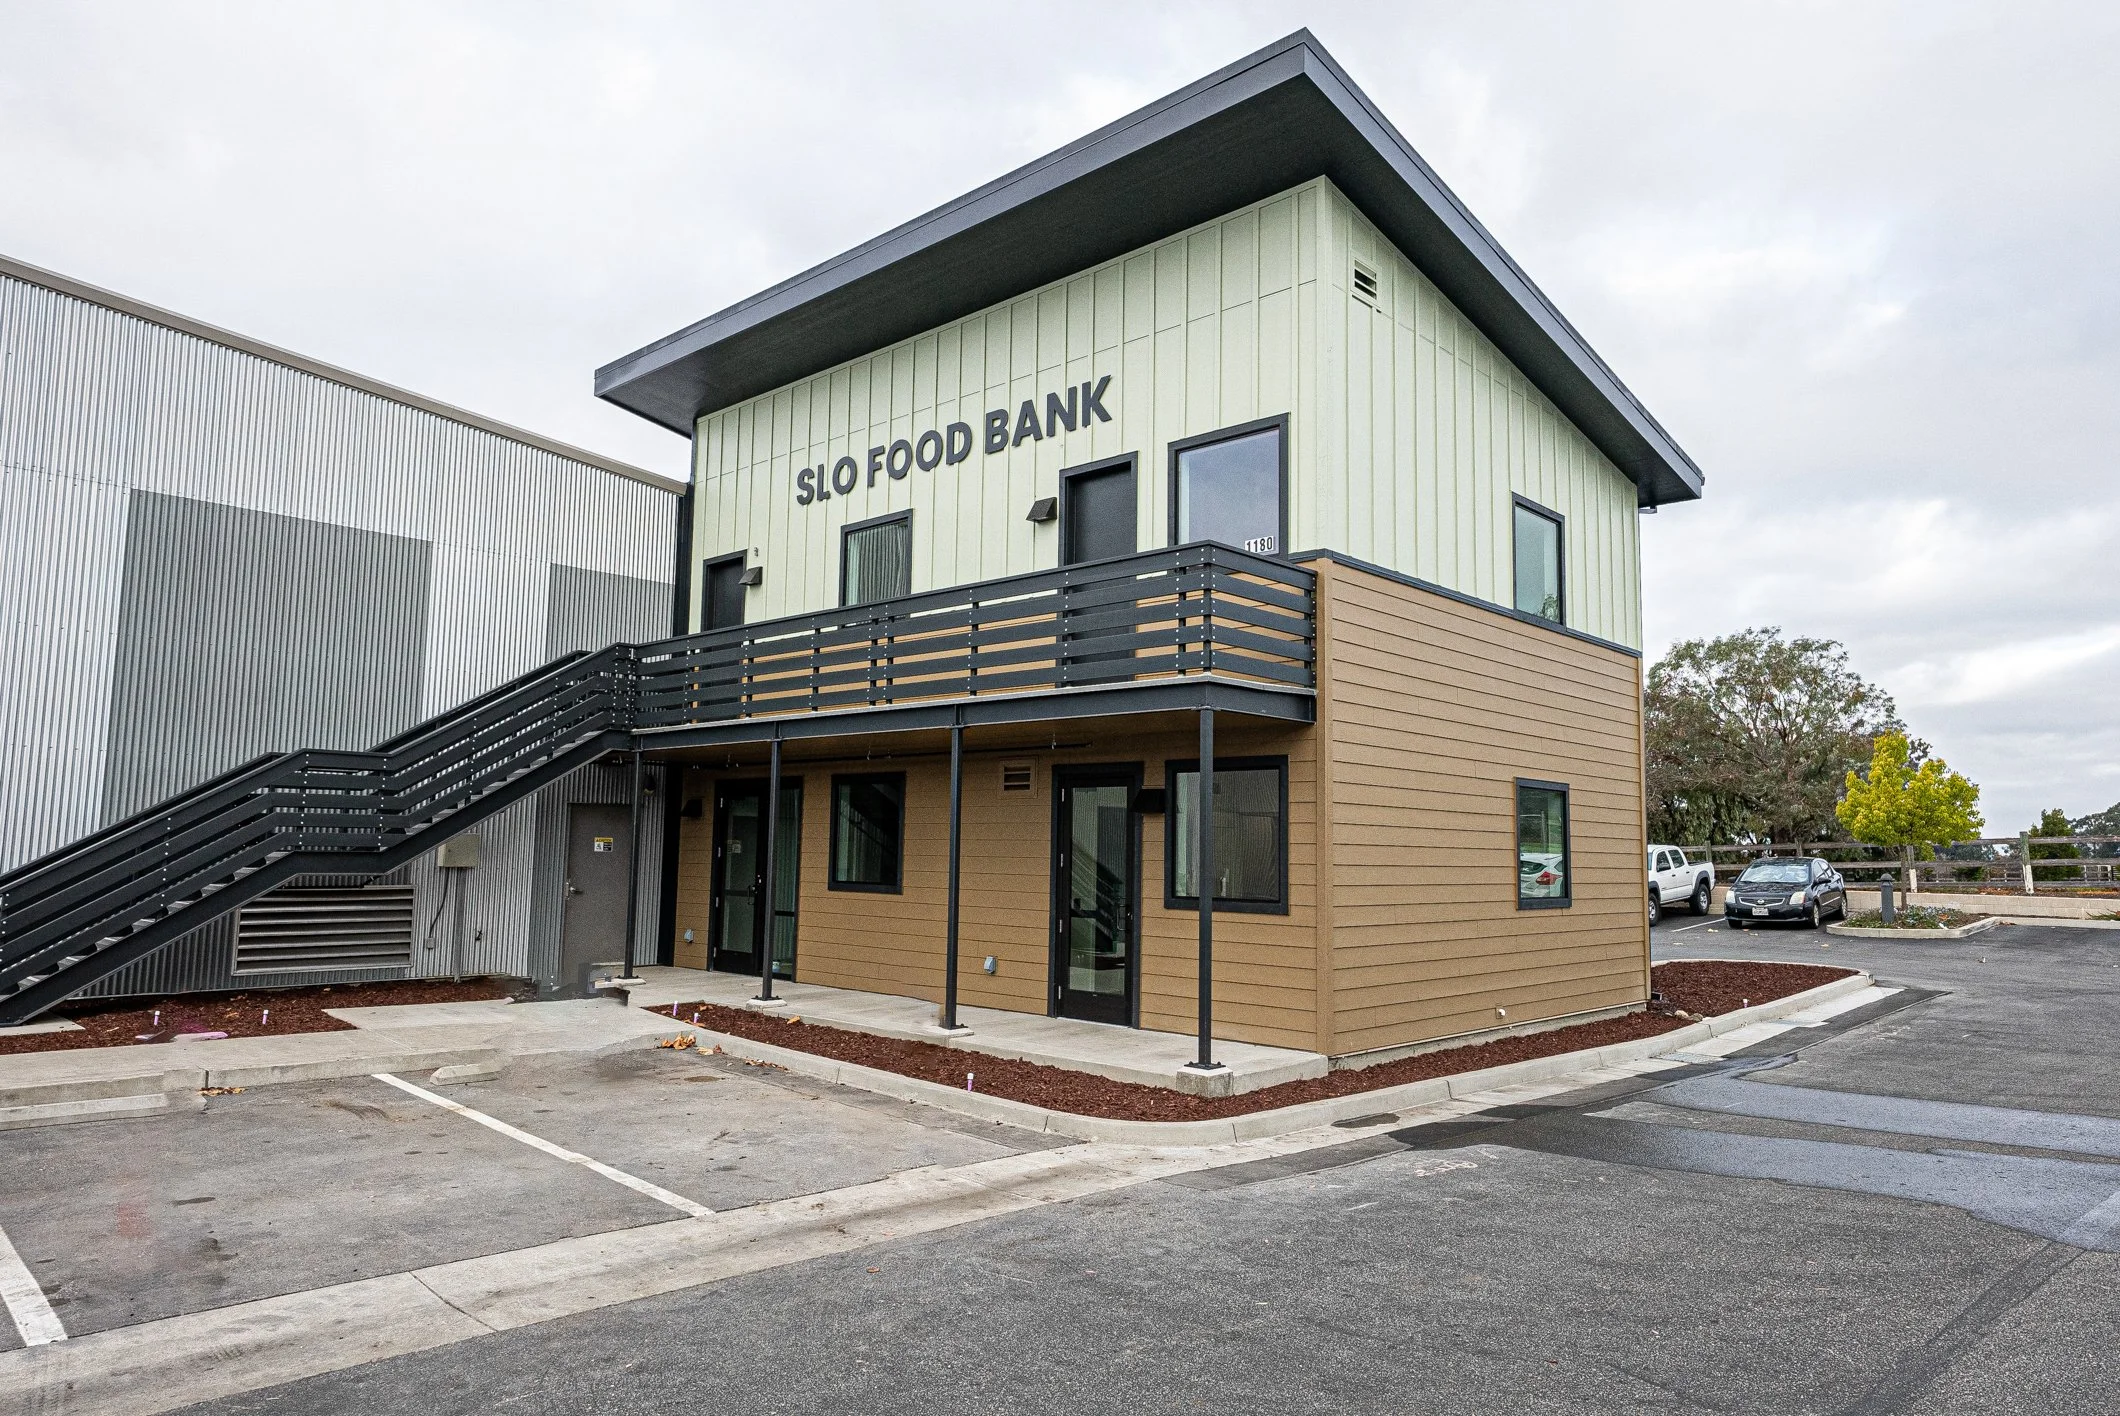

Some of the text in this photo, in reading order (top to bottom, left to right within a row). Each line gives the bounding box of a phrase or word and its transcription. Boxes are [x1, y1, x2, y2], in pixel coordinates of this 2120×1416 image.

[796, 375, 1113, 506] SLO FOOD BANK
[1246, 536, 1273, 553] 1180
